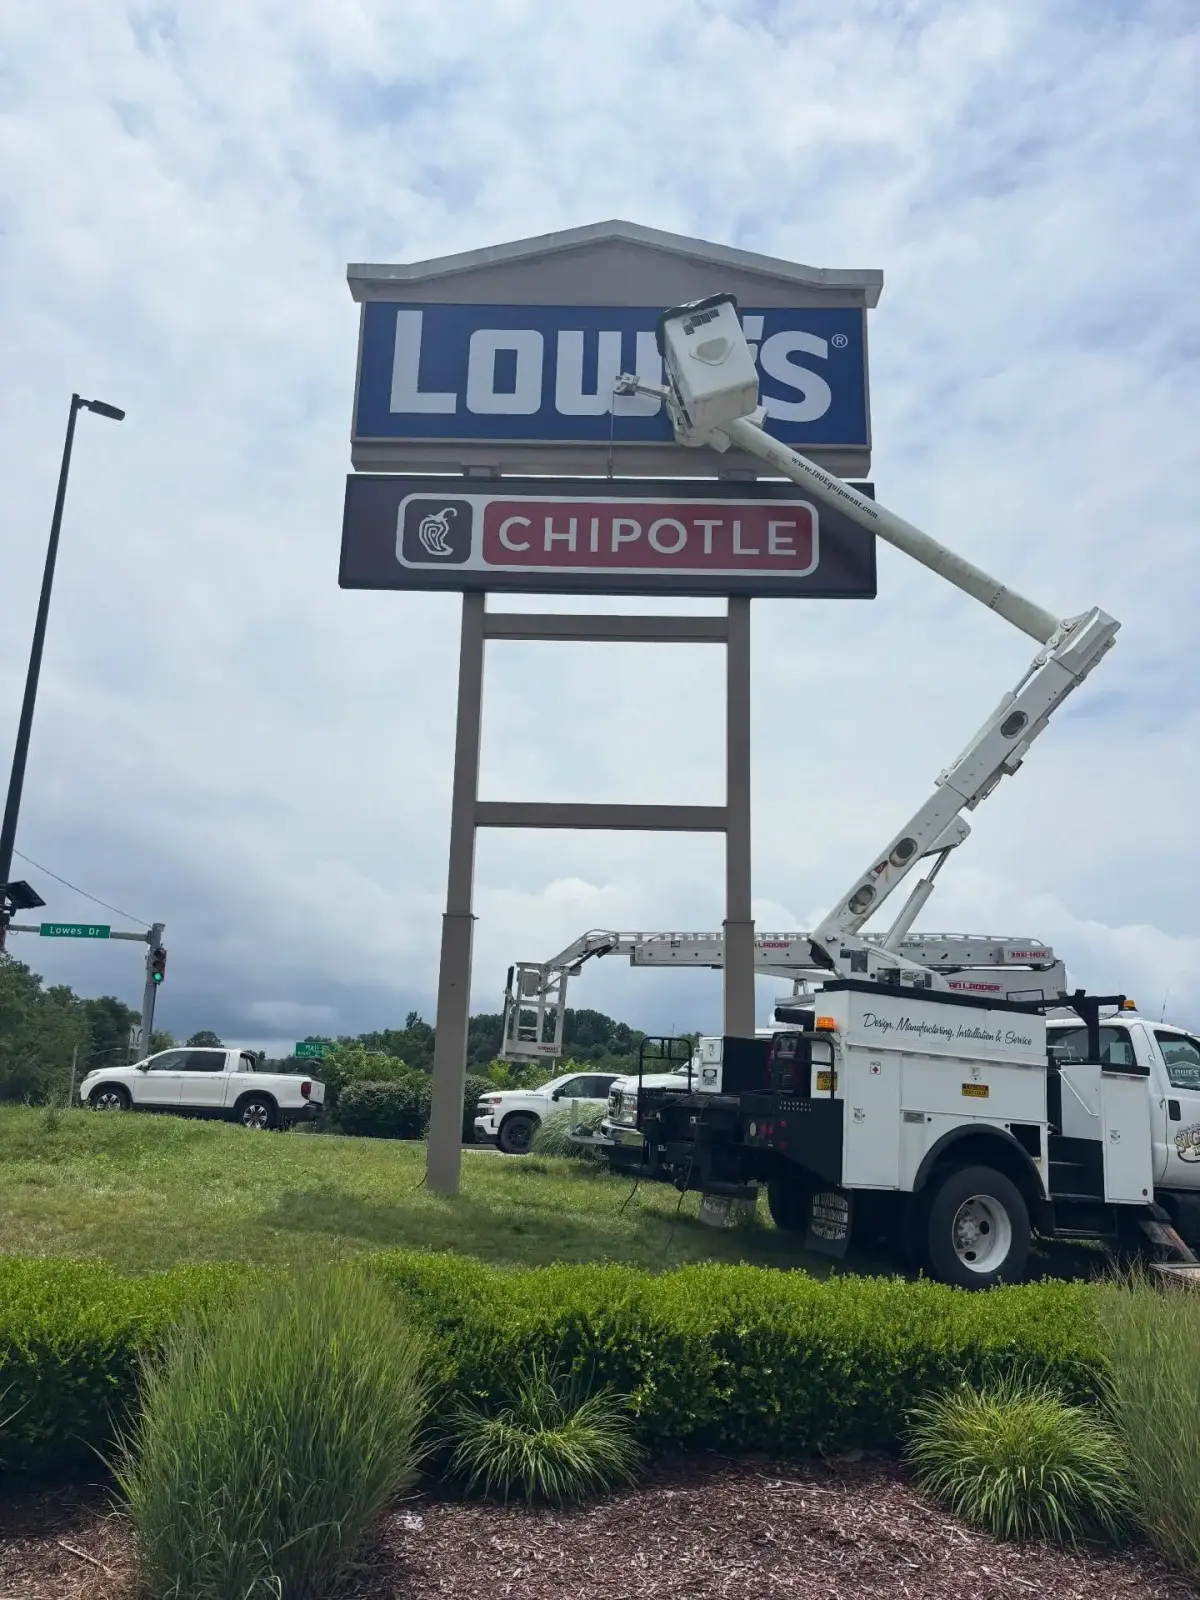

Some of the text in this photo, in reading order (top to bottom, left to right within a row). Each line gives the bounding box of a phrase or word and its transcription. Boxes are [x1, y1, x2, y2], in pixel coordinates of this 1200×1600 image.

[390, 310, 832, 422] LOW'S
[498, 516, 797, 556] CHIPOTLE
[49, 926, 101, 936] Lowes Dr
[963, 982, 1000, 991] LADDER
[956, 1025, 994, 1041] Installation
[995, 1029, 1002, 1042] &
[1004, 1031, 1032, 1046] Service
